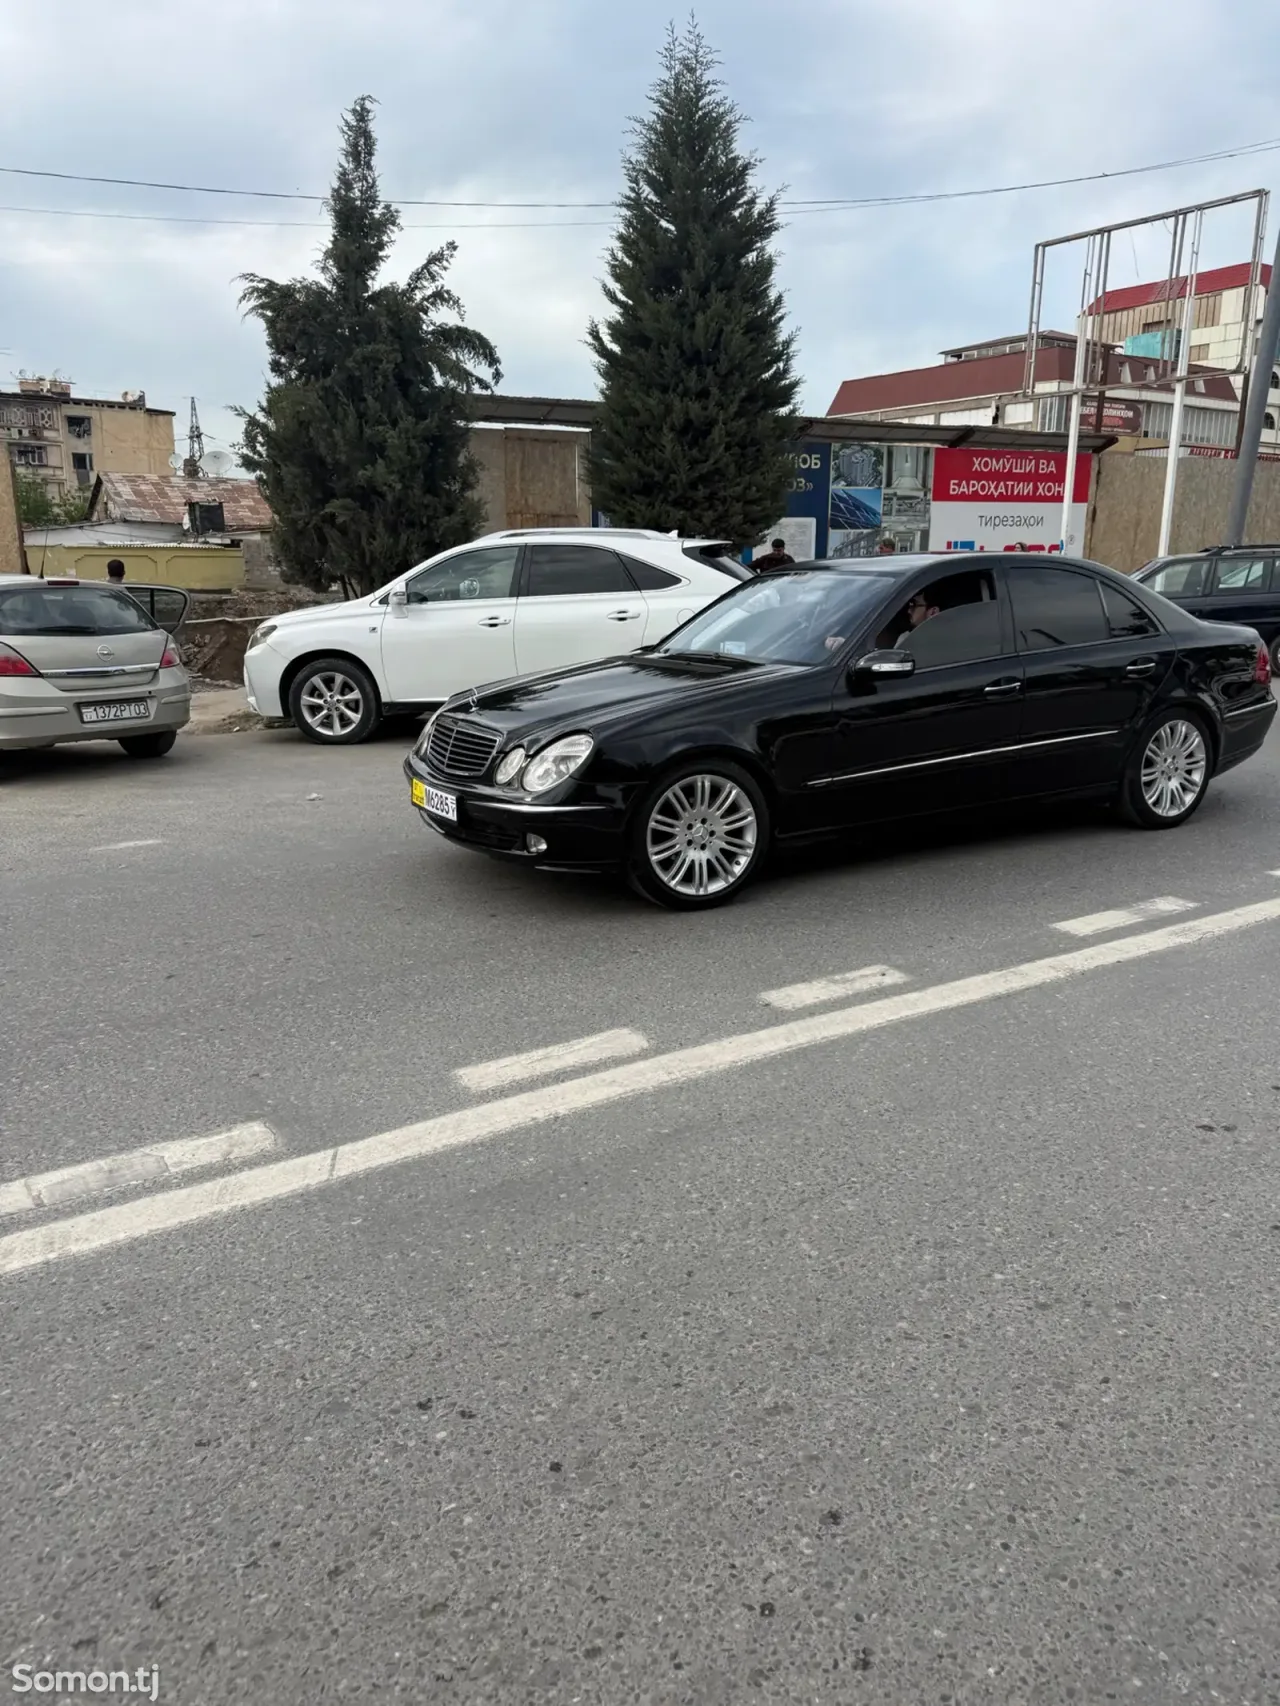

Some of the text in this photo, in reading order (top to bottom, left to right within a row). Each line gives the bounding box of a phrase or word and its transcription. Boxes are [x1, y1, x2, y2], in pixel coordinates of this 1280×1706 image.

[972, 455, 1057, 474] ХОМӮШӢ ВА
[950, 480, 1065, 498] БАРОҲАТИИ ХОН
[978, 514, 1044, 530] тирезаҳои
